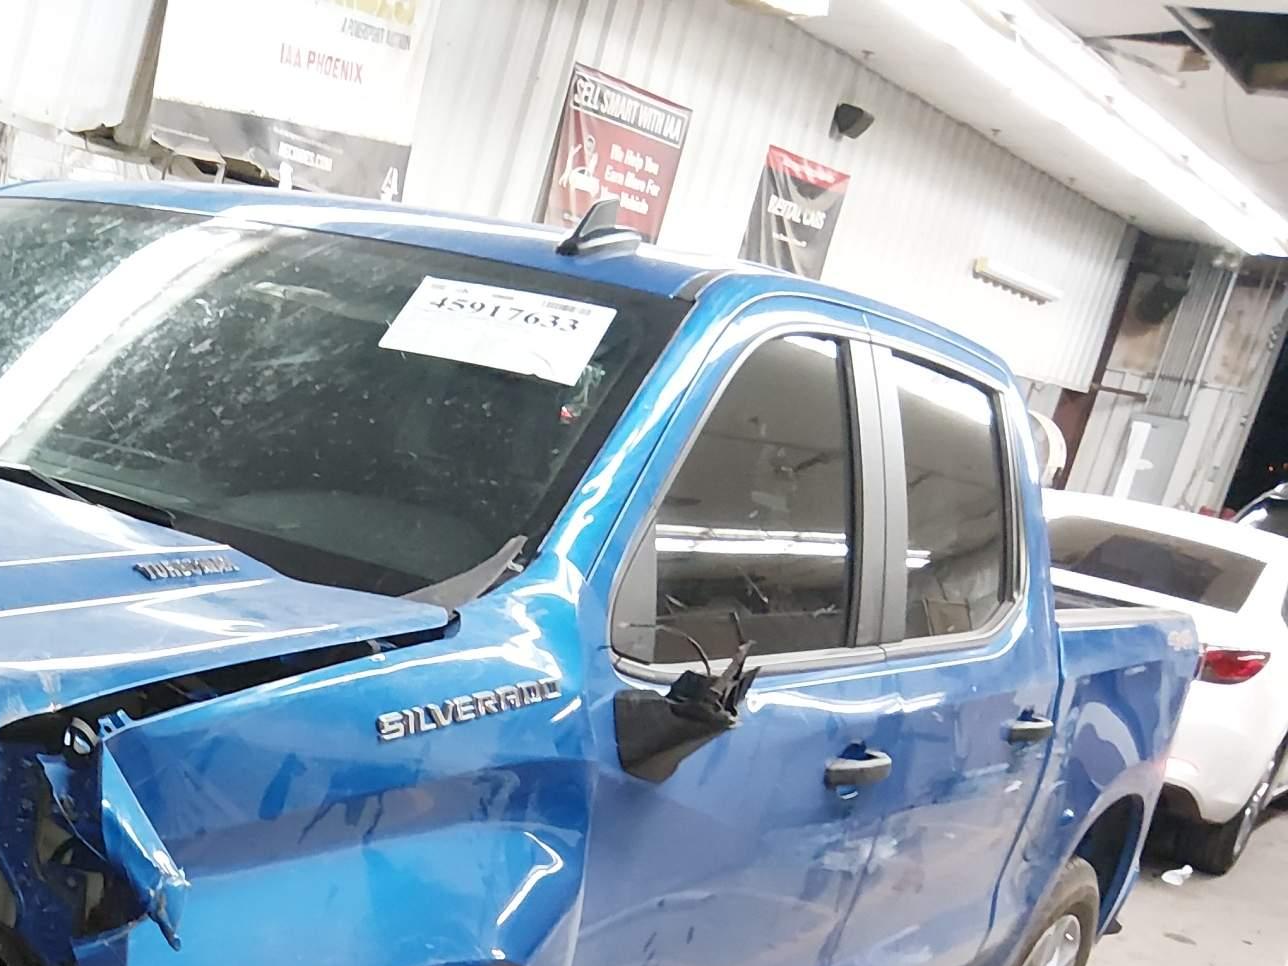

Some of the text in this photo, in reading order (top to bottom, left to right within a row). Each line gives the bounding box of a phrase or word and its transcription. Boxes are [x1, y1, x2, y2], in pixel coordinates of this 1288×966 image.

[280, 42, 364, 84] IAA PHOENIX
[574, 78, 683, 142] SELL SMART WITH IAA
[429, 297, 580, 333] 45917633
[376, 676, 563, 743] SILVERADO
